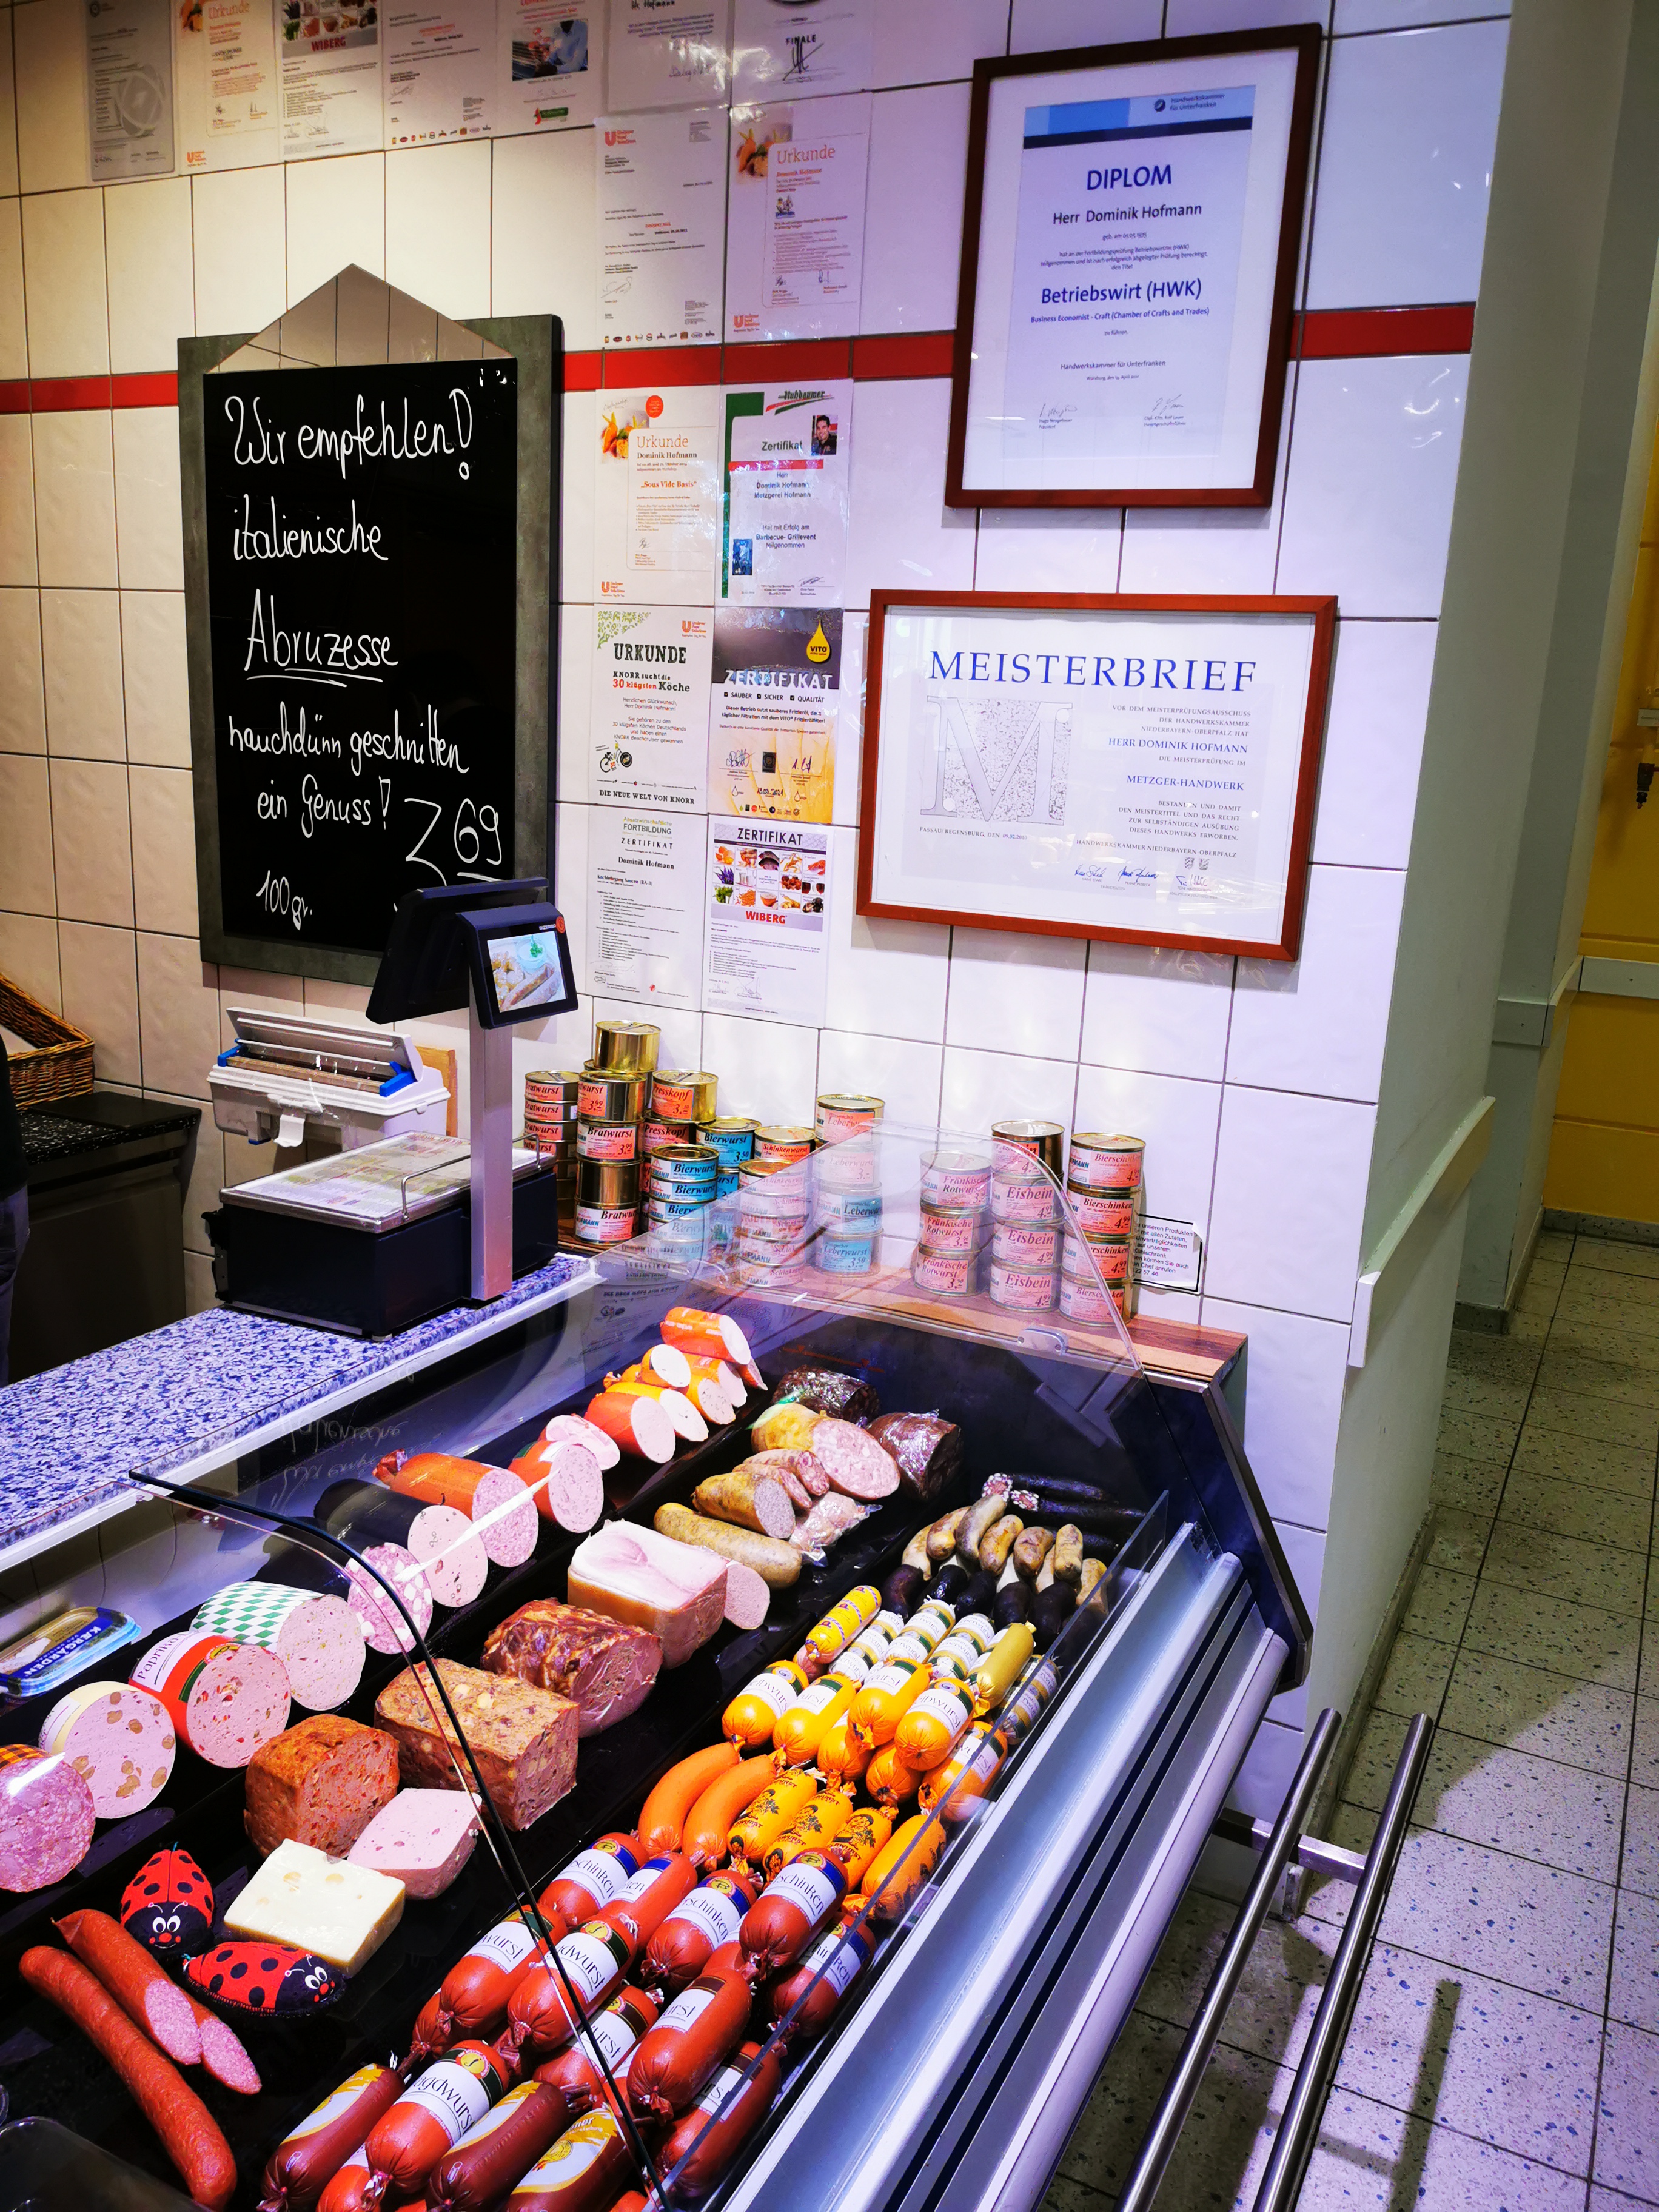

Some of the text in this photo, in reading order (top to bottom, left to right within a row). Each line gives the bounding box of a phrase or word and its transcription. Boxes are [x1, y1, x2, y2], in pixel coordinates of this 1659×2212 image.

[311, 36, 346, 51] WIBERG
[786, 34, 816, 45] FINALE
[777, 145, 836, 164] Urkunde
[1087, 164, 1173, 190] DIPLOM
[1053, 204, 1202, 225] Herr Dominik Hofmann
[1041, 278, 1201, 304] Betriebswirt (HWK)
[1031, 315, 1057, 324] Business
[1057, 313, 1090, 322] Economist
[1094, 312, 1111, 320] Craft
[1111, 310, 1142, 321] (Chamber
[1151, 309, 1171, 318] Crafts
[1172, 308, 1184, 317] and
[1185, 307, 1210, 317] Trades)
[1061, 362, 1116, 371] Handwerkskammer
[1127, 360, 1166, 368] Unterfranken
[225, 395, 286, 466] Wir
[637, 434, 689, 449] Urkunde
[762, 440, 803, 451] Zertifikat
[233, 493, 389, 560] italienische
[783, 523, 800, 532] Erfolg
[614, 643, 686, 665] URKUNDE
[928, 651, 1256, 692] MEISTERBRIEF
[612, 679, 690, 692] 30 klügsten Köche
[724, 669, 833, 690] ZERTIFIKAT
[1146, 706, 1252, 717] MEISTERPRÜFUNGSAUSSCHUSS
[1176, 718, 1250, 727] HANDWERKSKAMMER
[228, 701, 470, 777] hauchdünn geschnitten
[1108, 737, 1248, 754] HERR DOMINIK HOFMANN
[1173, 756, 1234, 766] MEISTERPRÜFUNG
[1127, 775, 1245, 791] METZGER-HANDWERK
[256, 780, 287, 820] ein
[613, 790, 631, 799] NEUE
[632, 792, 652, 800] WELT
[653, 794, 668, 802] VON
[669, 795, 695, 805] KNORR
[1135, 808, 1181, 817] MEISTERTITEL
[623, 823, 672, 835] FORTBILDUNG
[1144, 818, 1199, 828] SELBSTÄNDIGEN
[1202, 822, 1239, 831] AUSÜBUNG
[737, 828, 803, 846] ZERTIFIKAT
[945, 828, 986, 838] REGENSBURG,
[1155, 828, 1197, 837] HANDWERKS
[1200, 832, 1238, 841] ERWORBEN.
[621, 837, 673, 850] ZERTIFIKAT
[1076, 839, 1145, 851] HANDWERKSKAMMER
[618, 856, 674, 870] Dominik Hofmann
[745, 910, 786, 924] WIBERG
[526, 1081, 559, 1094] Bratwurst
[653, 1084, 692, 1100] Presskopf
[525, 1101, 559, 1114] Bratwurst
[588, 1125, 633, 1138] Bratwurst
[645, 1124, 688, 1138] Presskopf
[704, 1132, 748, 1144] Bierwurst
[618, 1144, 633, 1156] 3.99
[763, 1143, 808, 1153] Schinkenwurst
[674, 1163, 716, 1173] Bierwurst
[675, 1184, 716, 1195] Bierwurst
[1007, 1186, 1053, 1199] Eisbein
[1084, 1197, 1133, 1210] Bierschinken
[1037, 1205, 1053, 1219] 4.99
[927, 1216, 973, 1228] Fränkische
[1114, 1215, 1131, 1229] 4.99
[927, 1224, 964, 1237] Rotwurst
[1008, 1228, 1053, 1245] Eisbein
[1165, 1227, 1193, 1236] Produkten
[823, 1245, 868, 1256] Leberwurst
[922, 1256, 967, 1270] Fränkische
[1111, 1260, 1127, 1273] 4.99
[1155, 1265, 1176, 1273] anrufen
[921, 1265, 957, 1278] Rotwurst
[1005, 1273, 1051, 1289] Eisbein
[1035, 1295, 1051, 1307] 4.99
[23, 1625, 102, 1677] KÆRGÅRDEN
[413, 2076, 475, 2136] agdwurst
